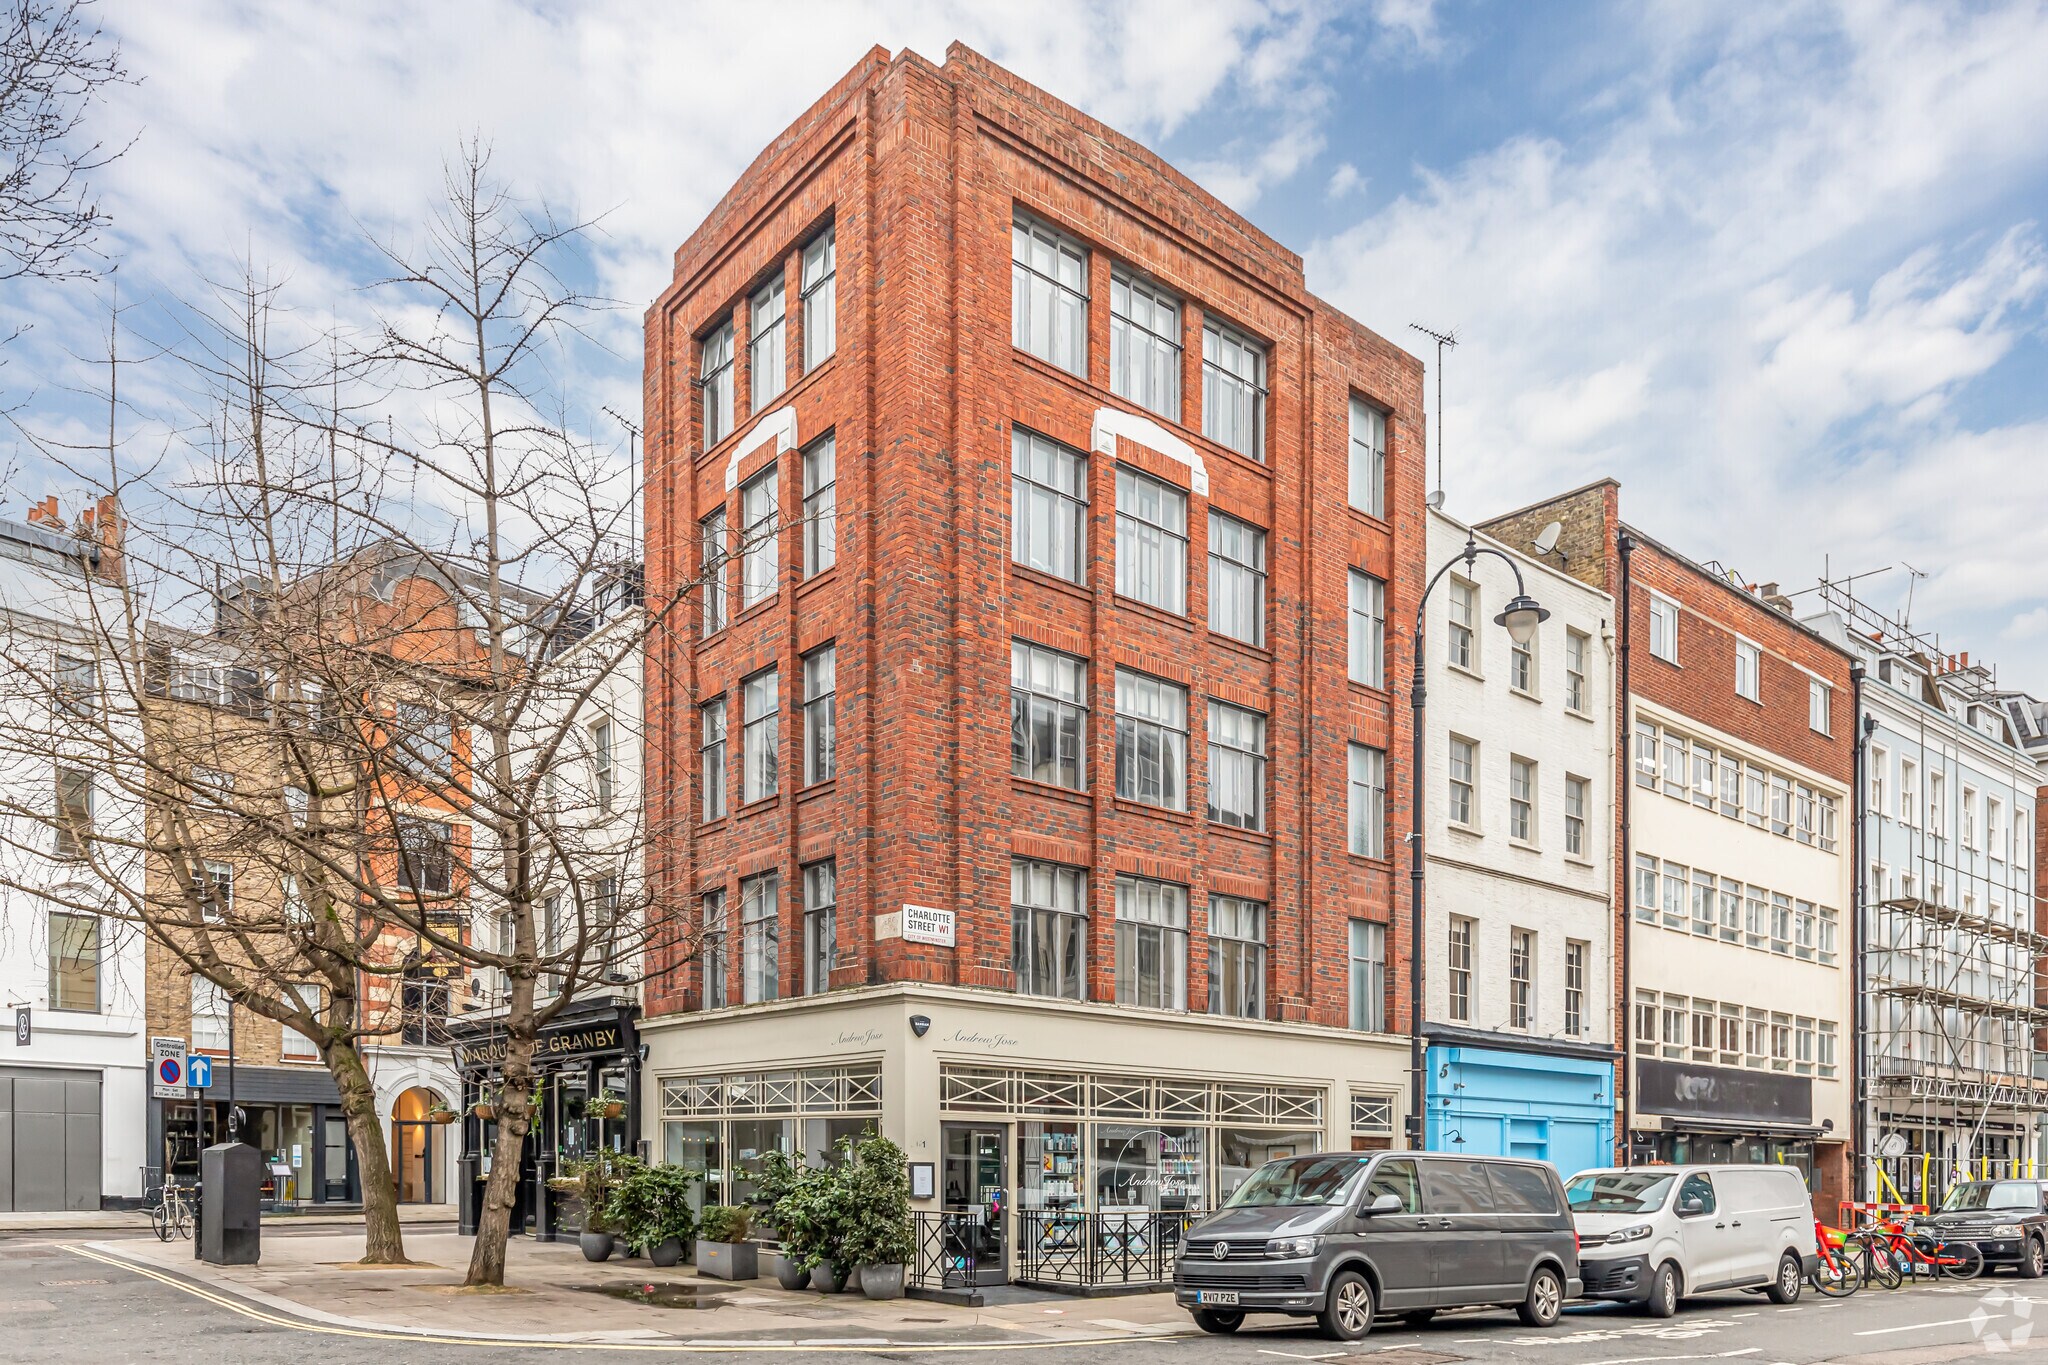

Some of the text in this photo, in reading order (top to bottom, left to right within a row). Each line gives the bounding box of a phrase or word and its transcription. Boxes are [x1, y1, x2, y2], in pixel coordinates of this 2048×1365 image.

[908, 908, 950, 924] CHARLOTTE
[908, 920, 936, 932] STREET
[938, 924, 949, 934] W1
[550, 1029, 616, 1052] GRANBY
[831, 1028, 884, 1046] Andrew Jose
[943, 1029, 1019, 1048] Andrew Jose
[156, 1042, 184, 1050] Controlled
[1439, 1064, 1450, 1078] 5
[1118, 1172, 1186, 1191] Andrew Jose
[1203, 1293, 1236, 1302] RV17 PZE
